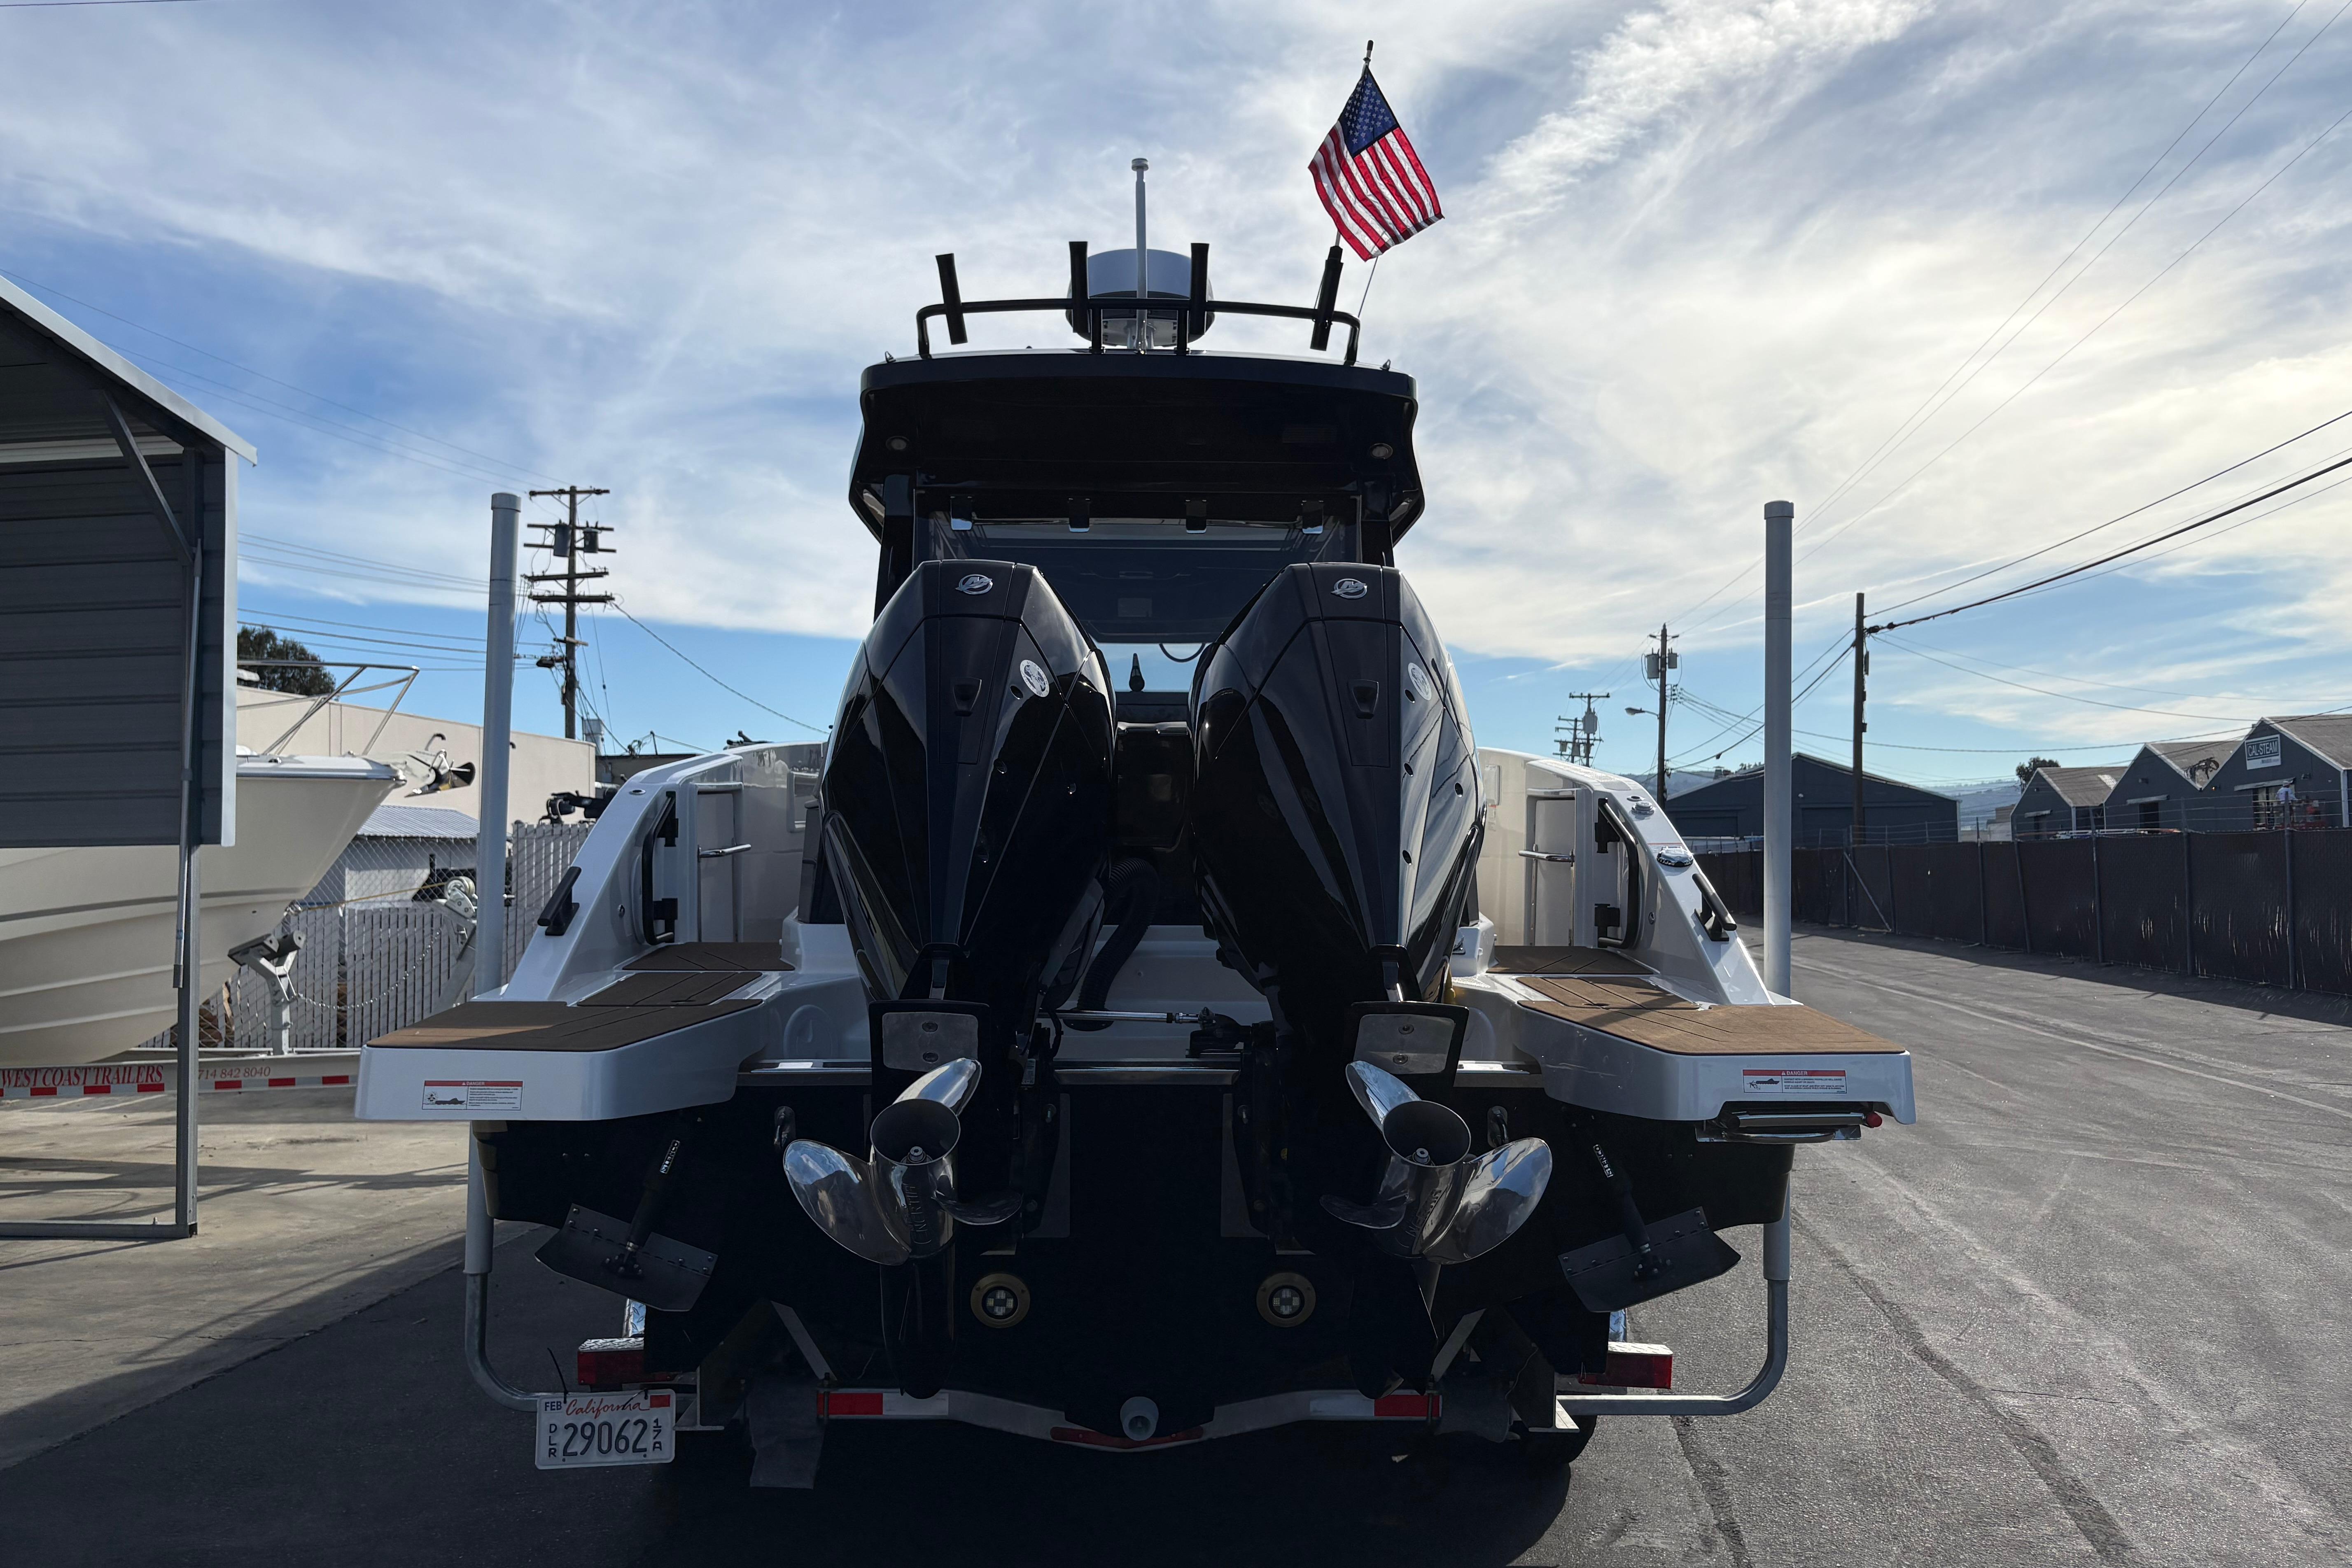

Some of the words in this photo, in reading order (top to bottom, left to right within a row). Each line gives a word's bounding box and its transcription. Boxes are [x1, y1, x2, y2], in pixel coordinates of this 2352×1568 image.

[2248, 741, 2277, 756] CAL-STEAM
[1, 1069, 41, 1087] WEST
[42, 1066, 91, 1086] COAST
[92, 1065, 163, 1085] TRAILERS
[198, 1069, 217, 1080] 714
[220, 1068, 241, 1078] 842
[243, 1066, 271, 1077] 8040
[545, 1401, 562, 1411] FEB
[566, 1398, 650, 1419] California
[563, 1419, 648, 1456] 29062
